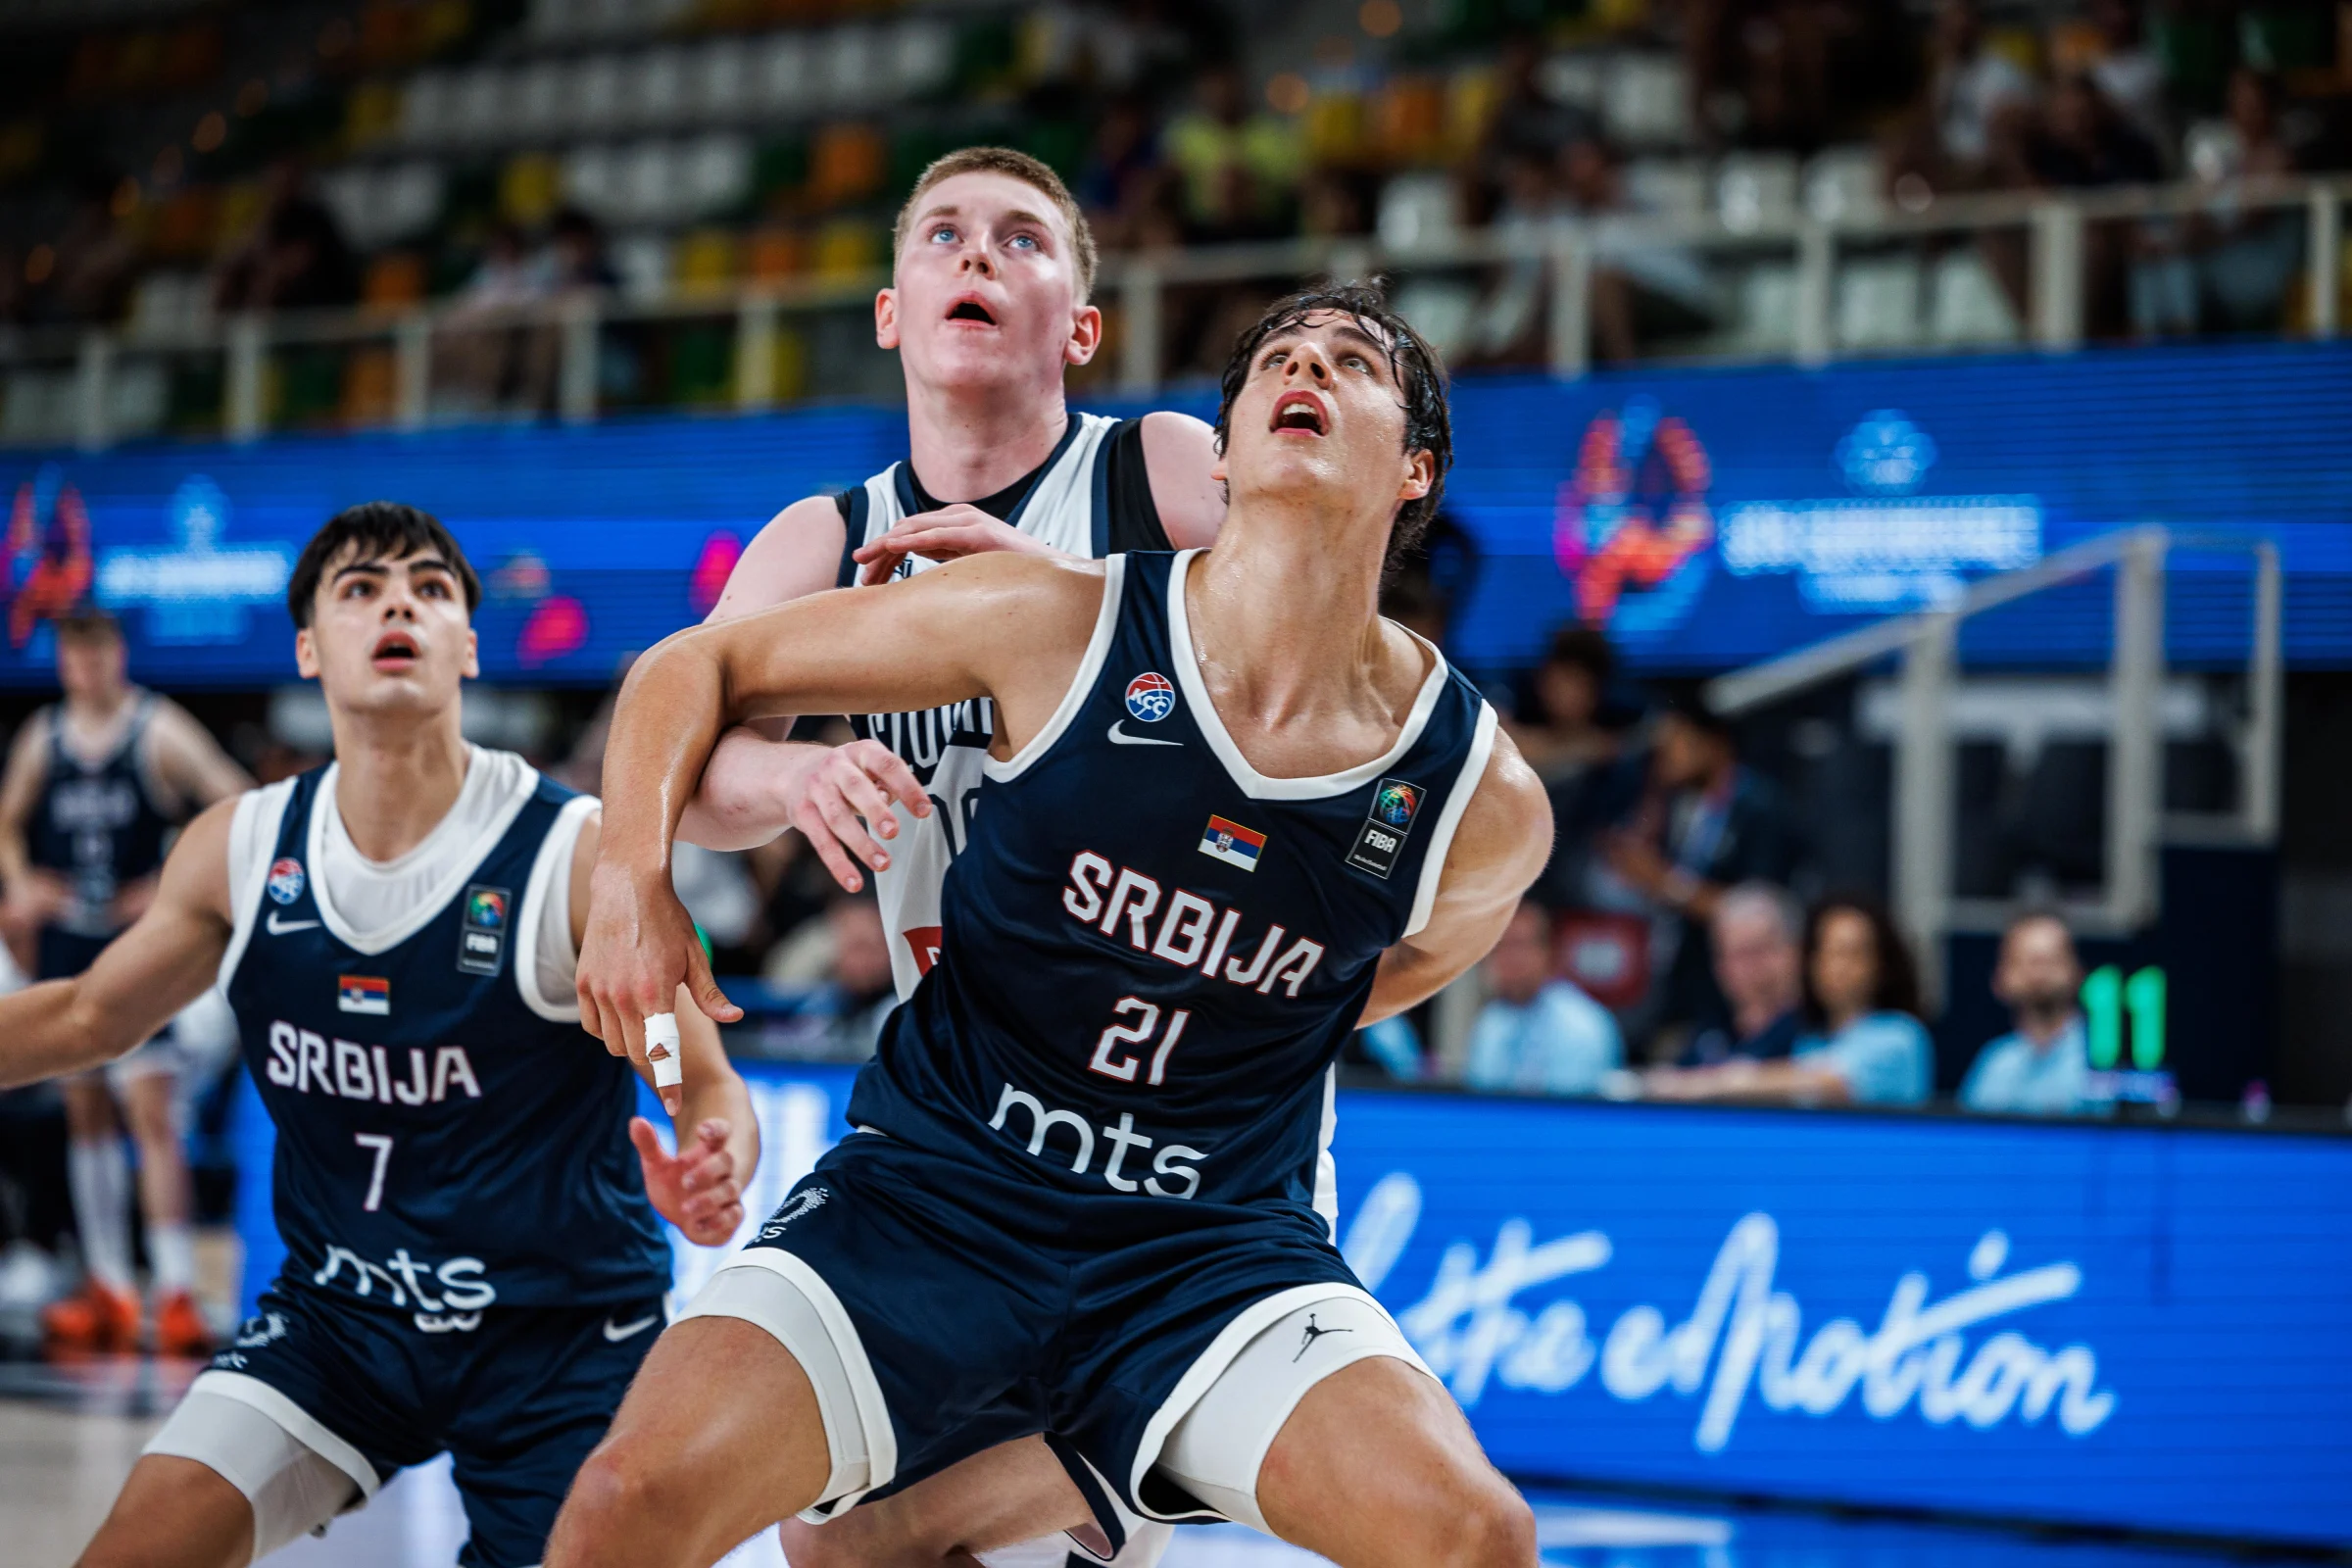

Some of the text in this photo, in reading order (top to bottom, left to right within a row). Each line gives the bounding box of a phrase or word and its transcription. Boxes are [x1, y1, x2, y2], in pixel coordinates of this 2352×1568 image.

[1364, 829, 1397, 853] FIBA
[1061, 849, 1325, 999] SRBIJA
[1087, 995, 1191, 1086] 21
[2079, 963, 2167, 1070] 11
[267, 1019, 481, 1105] SRBIJA
[355, 1131, 394, 1211] 7
[988, 1082, 1209, 1200] mts
[314, 1243, 497, 1311] mts
